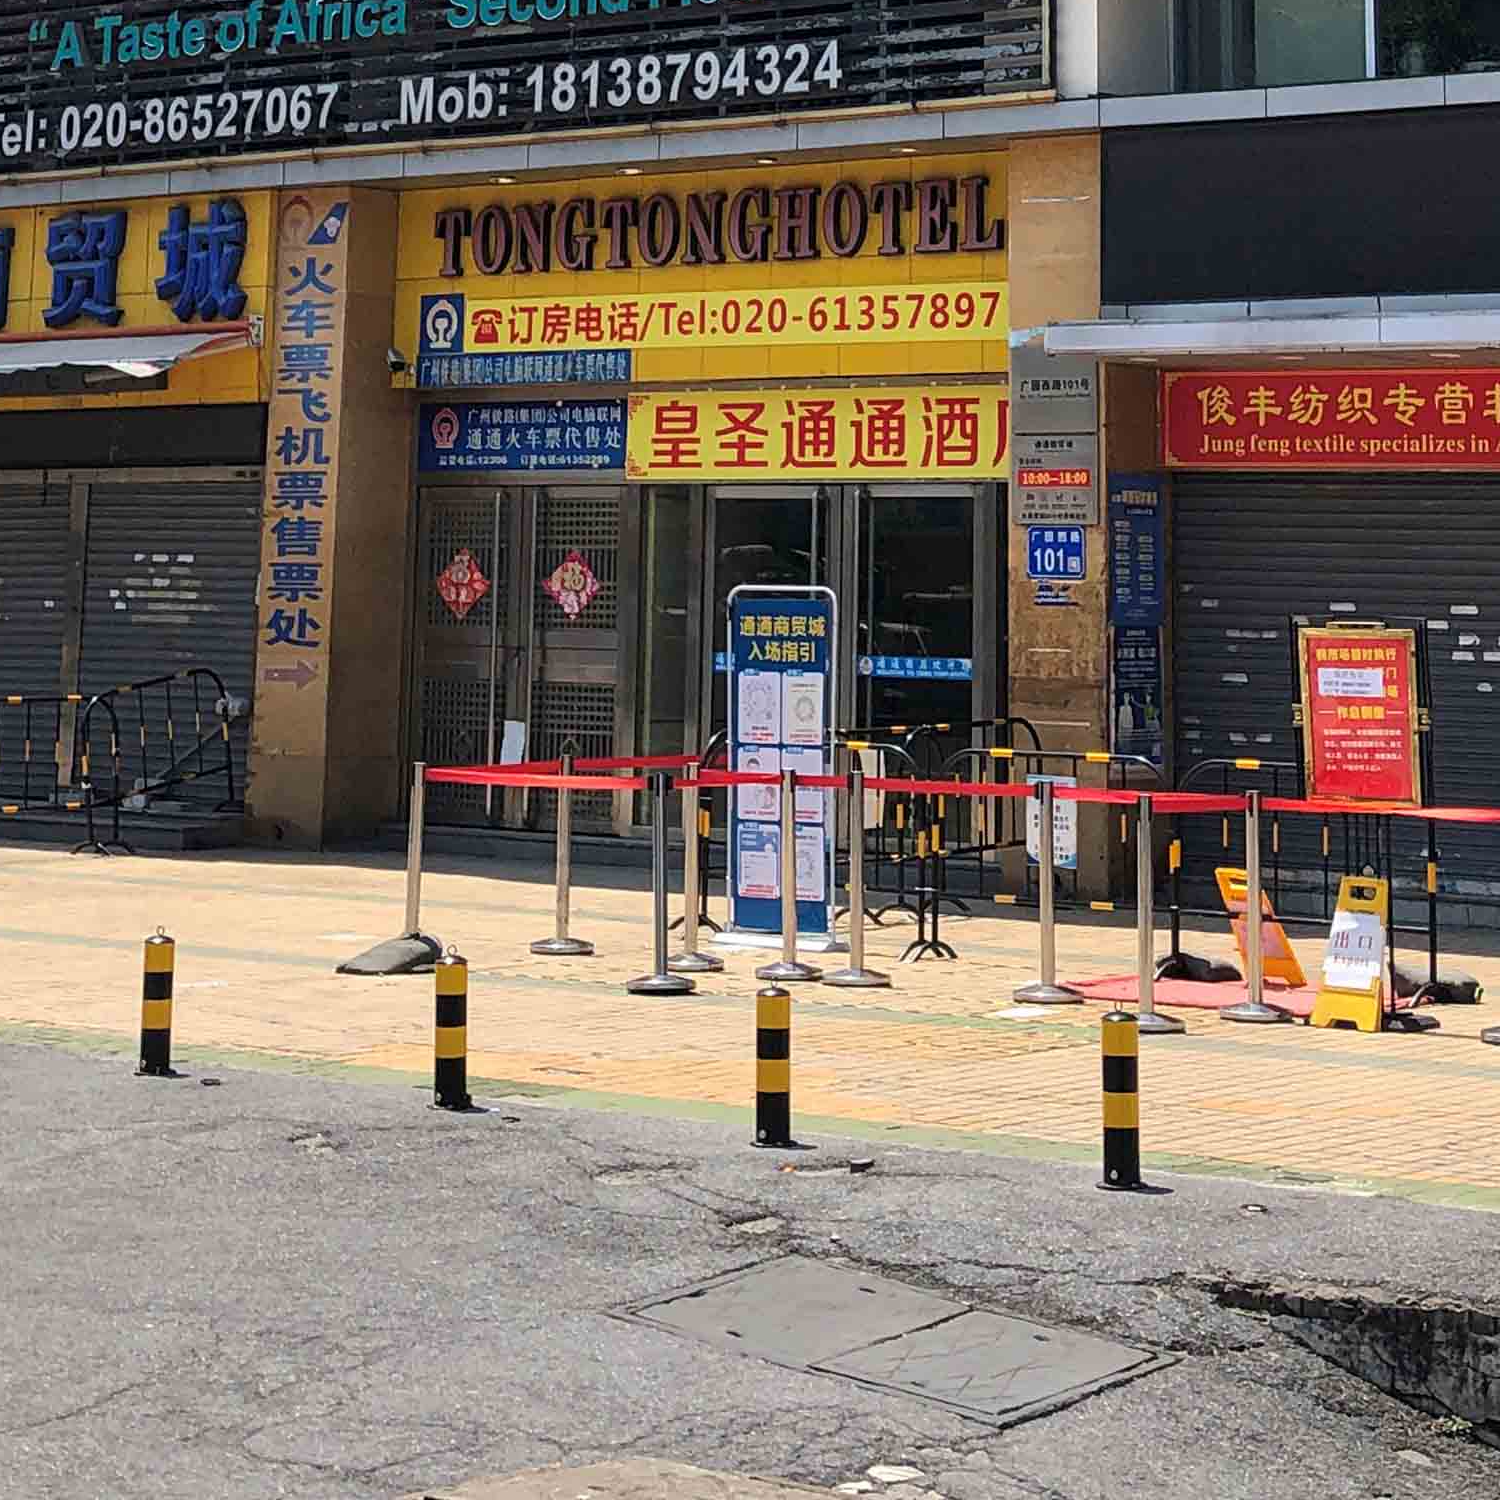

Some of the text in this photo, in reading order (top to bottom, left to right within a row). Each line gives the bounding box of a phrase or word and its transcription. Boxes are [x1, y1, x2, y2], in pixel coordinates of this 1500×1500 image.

[96, 12, 206, 68] Taste
[215, 0, 264, 53] of
[61, 84, 338, 151] 020-86527067
[400, 72, 507, 127] Mob:
[525, 41, 842, 115] 18138794324
[466, 426, 622, 451] 通通火车票代售处
[1199, 434, 1245, 457] Jung
[1250, 433, 1290, 457] feng
[1295, 434, 1355, 454] textile
[1360, 433, 1466, 457] specializes
[1471, 433, 1490, 453] in
[265, 256, 338, 649] 火车票飞机票售票处
[1033, 547, 1064, 573] 101
[739, 615, 827, 637] 通通商贸城
[748, 641, 816, 663] 入场指引
